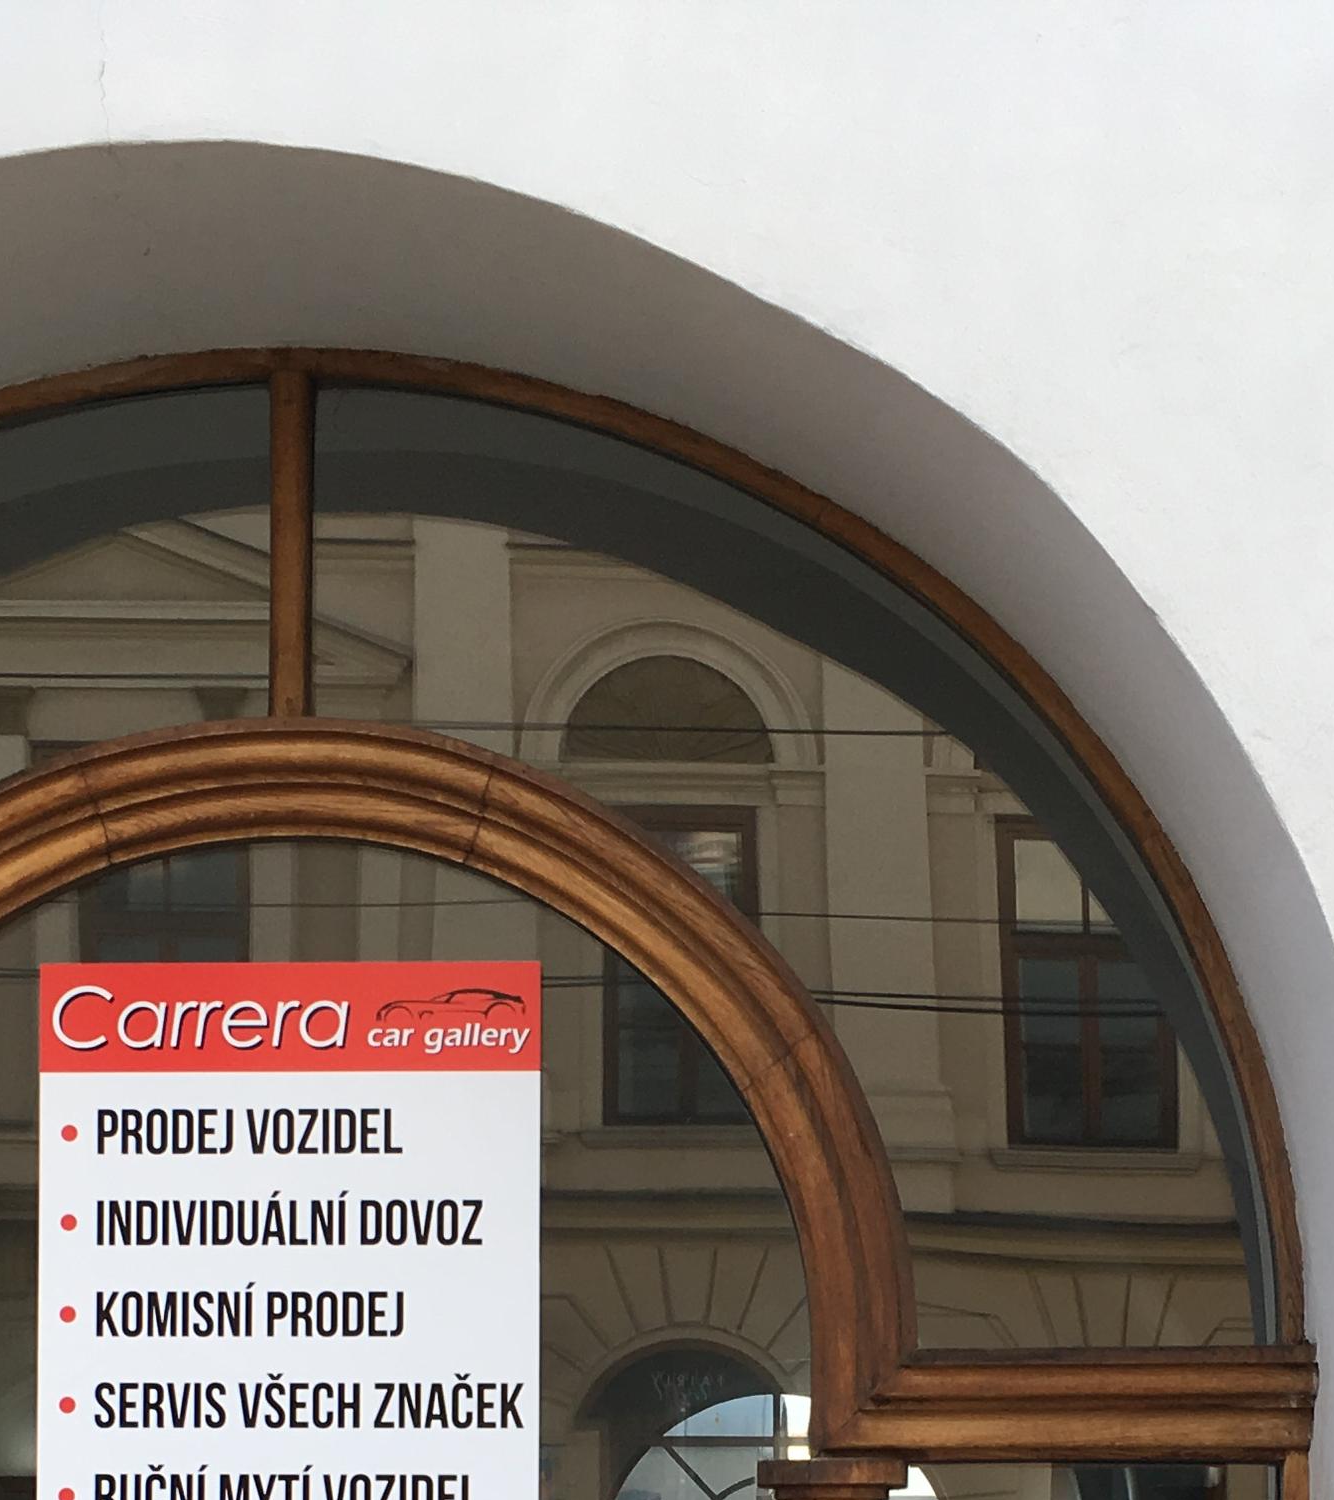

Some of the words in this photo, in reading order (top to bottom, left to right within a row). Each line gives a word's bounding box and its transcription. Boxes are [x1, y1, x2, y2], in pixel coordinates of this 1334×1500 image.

[51, 984, 350, 1050] Carrera
[366, 1024, 414, 1048] car
[423, 1022, 532, 1054] gallery
[96, 1108, 234, 1155] PRODEJ
[246, 1108, 404, 1155] VOZIDEL
[95, 1190, 350, 1246] INDIVIDUÁLNÍ
[359, 1199, 484, 1246] DOVOZ
[95, 1282, 257, 1339] KOMISNÍ
[267, 1290, 405, 1338] PRODEJ
[94, 1381, 227, 1430] SERVIS
[238, 1373, 362, 1430] VŠECH
[373, 1373, 525, 1430] ZNAČEK
